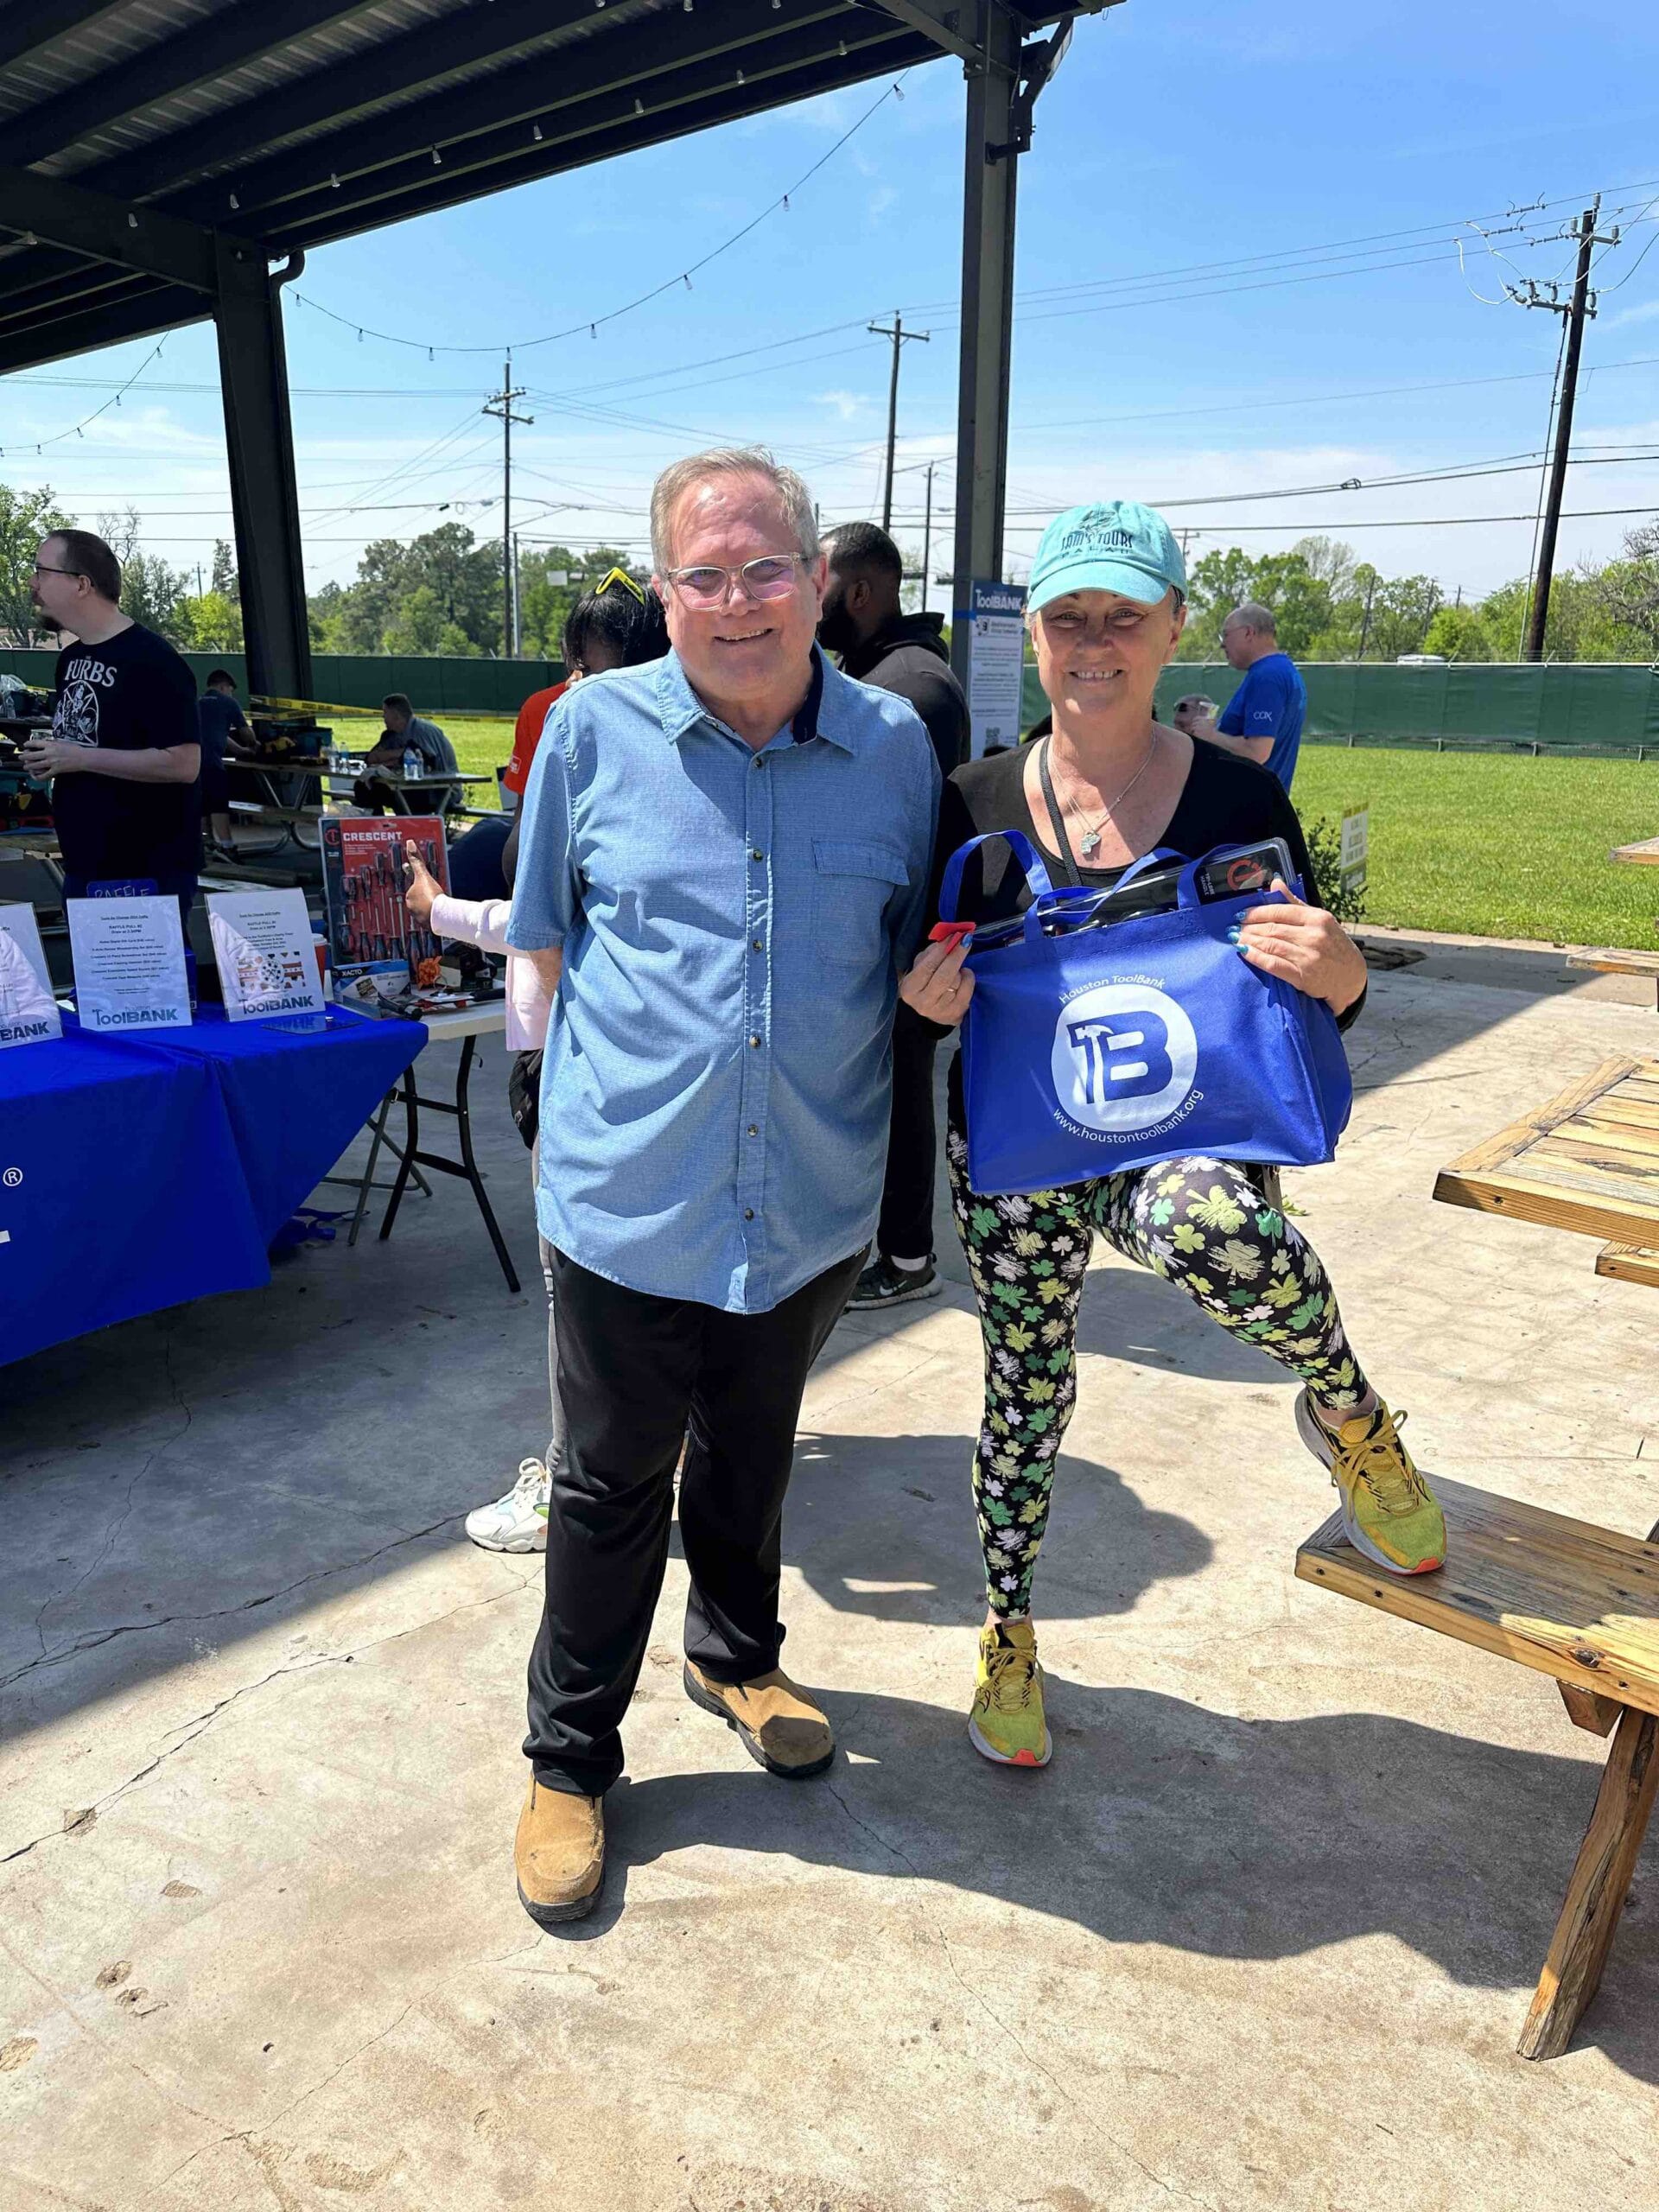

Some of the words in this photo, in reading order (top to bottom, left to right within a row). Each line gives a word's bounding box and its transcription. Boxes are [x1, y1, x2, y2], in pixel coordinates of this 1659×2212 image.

[1098, 529, 1134, 549] TOURS
[976, 588, 1022, 611] ToolBANK
[342, 831, 403, 842] CRESCENT
[1058, 978, 1109, 1004] Houston
[1111, 974, 1166, 990] ToolBank
[92, 1008, 178, 1026] ToolBANK
[1052, 1089, 1205, 1143] www.houstontoolbank.org
